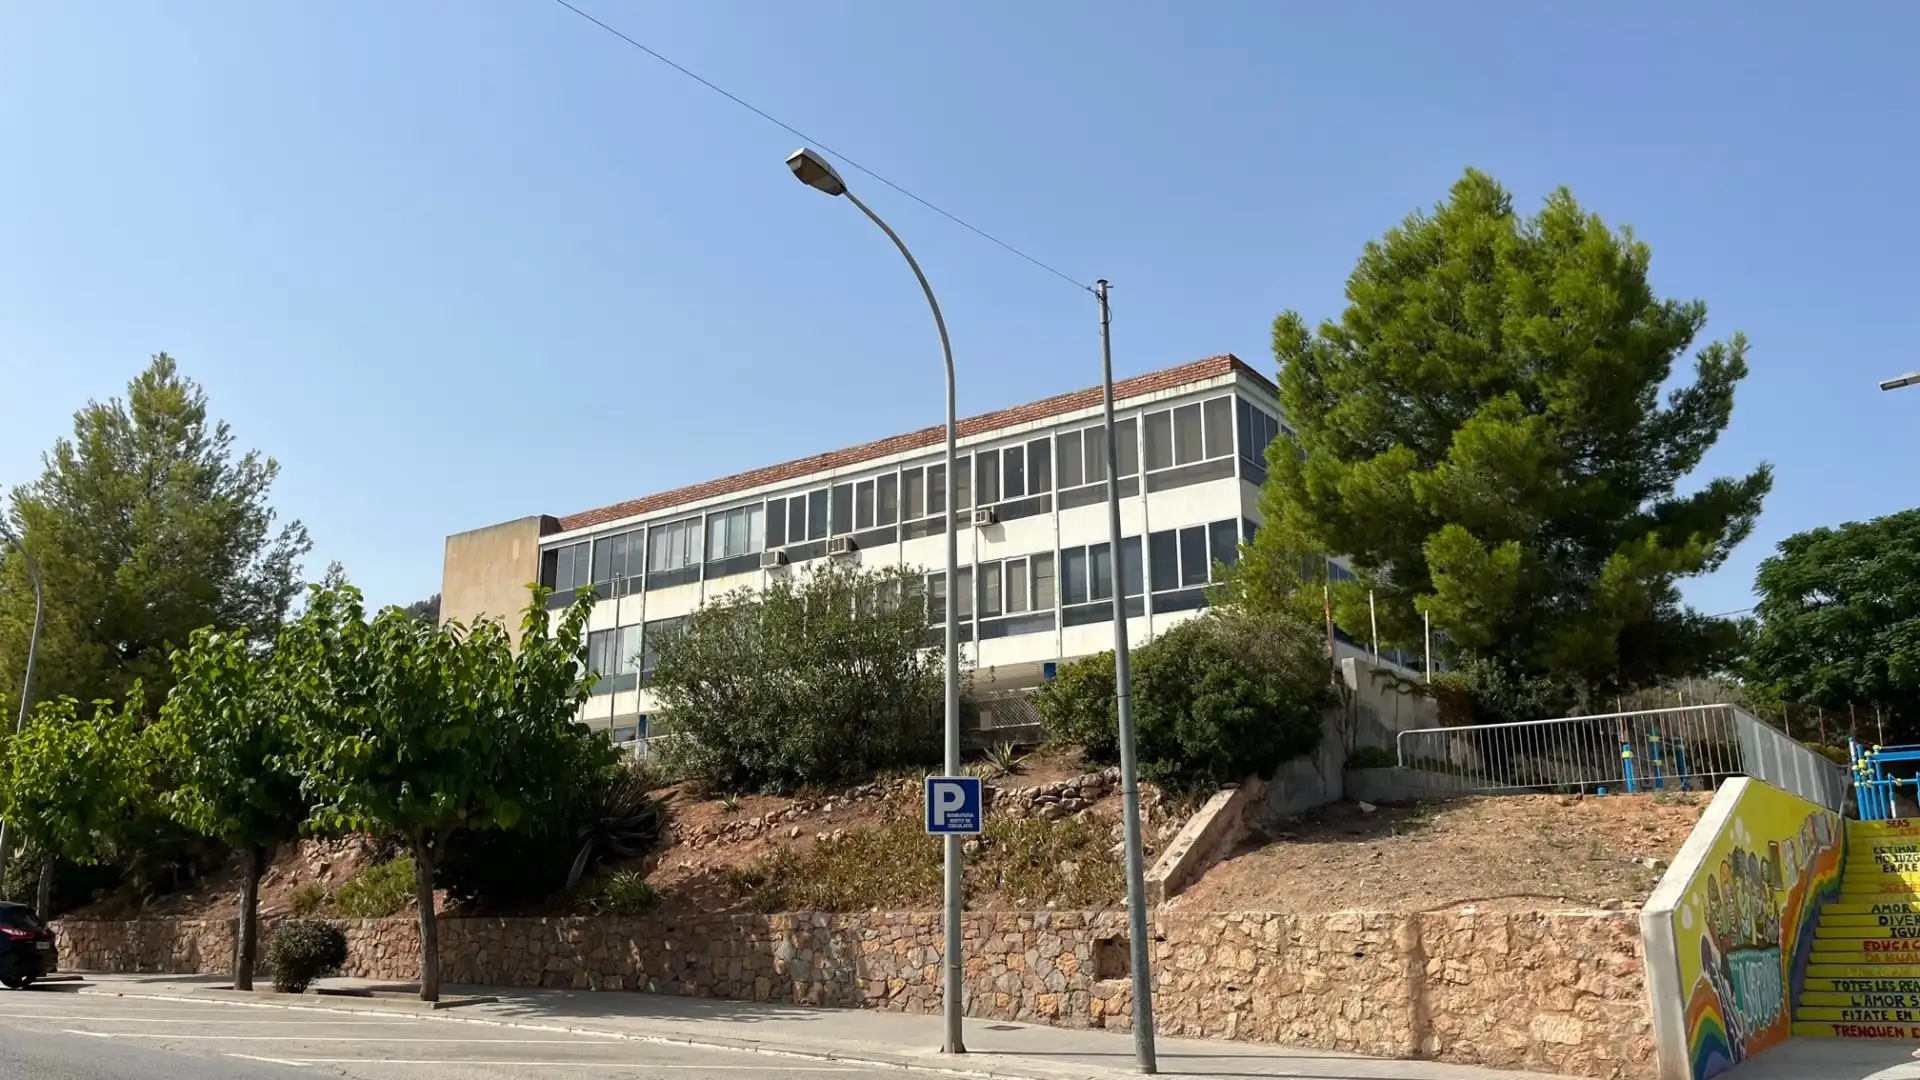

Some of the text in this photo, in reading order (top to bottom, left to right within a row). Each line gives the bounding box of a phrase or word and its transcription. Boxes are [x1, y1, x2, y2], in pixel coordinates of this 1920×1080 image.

[933, 782, 966, 826] P
[1871, 903, 1912, 914] AMOR
[1831, 980, 1873, 991] TOTES
[1875, 980, 1896, 991] LES
[1851, 995, 1906, 1007] L'AMOR
[1842, 1010, 1888, 1021] FIJATE
[1895, 1010, 1912, 1021] EN
[1831, 1024, 1905, 1038] TRENQUEN
